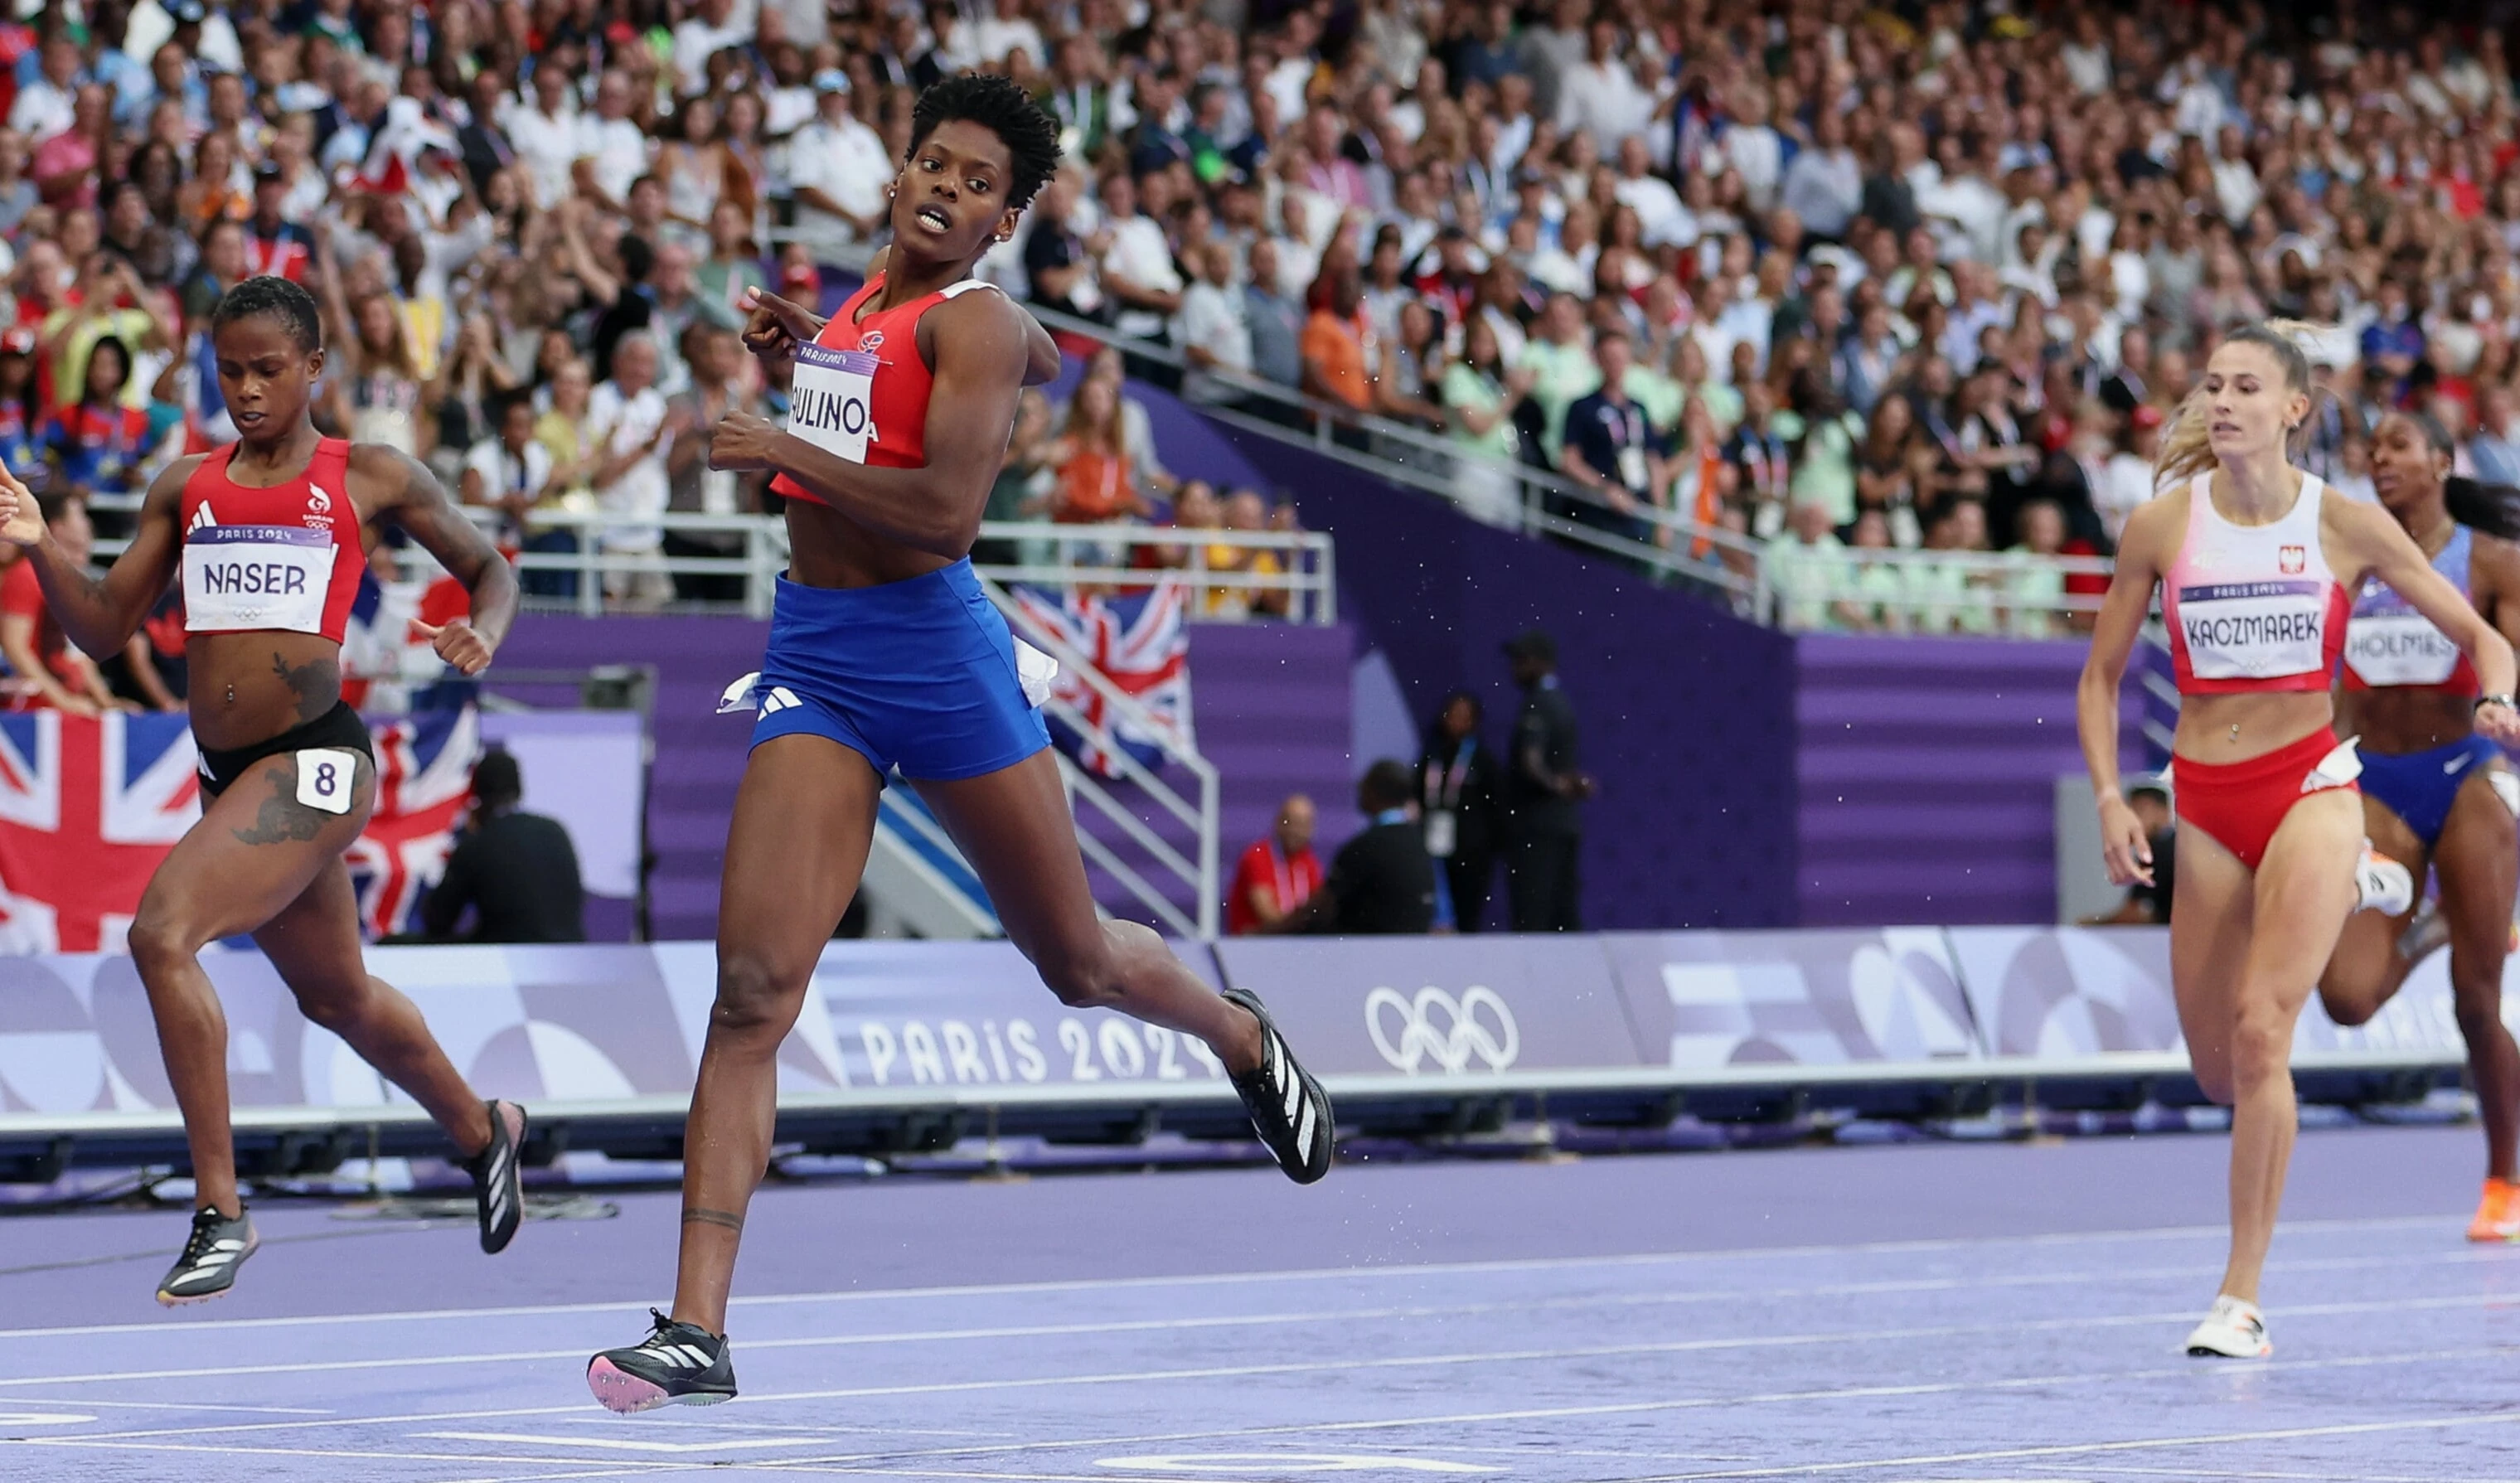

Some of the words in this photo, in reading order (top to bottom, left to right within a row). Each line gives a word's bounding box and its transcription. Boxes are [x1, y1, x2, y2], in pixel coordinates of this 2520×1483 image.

[216, 529, 254, 540] PARIS
[257, 529, 292, 540] 2024
[204, 562, 306, 595] NASER
[2186, 612, 2319, 648] KACZMAREK
[314, 763, 336, 797] 8
